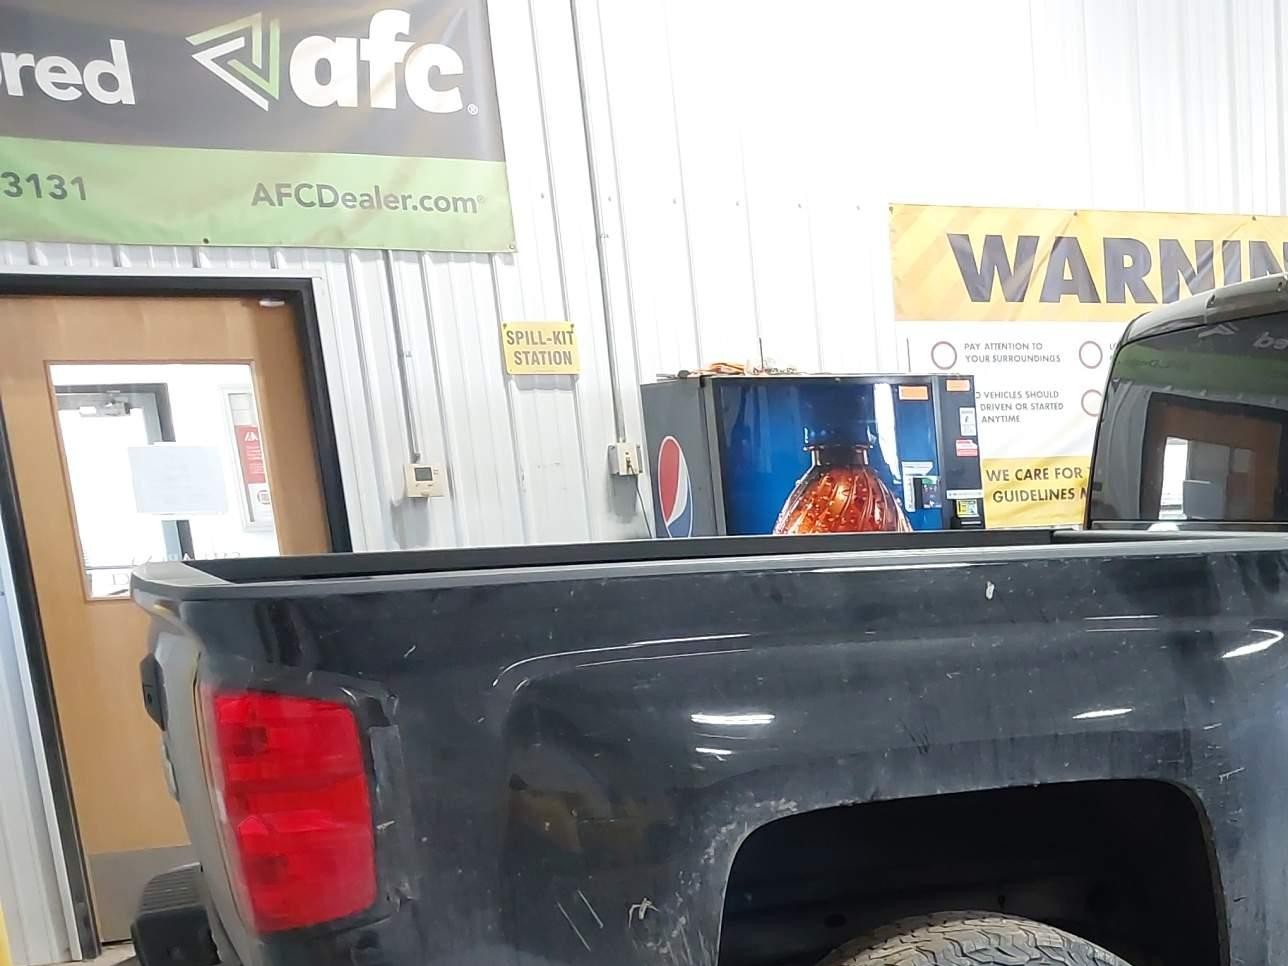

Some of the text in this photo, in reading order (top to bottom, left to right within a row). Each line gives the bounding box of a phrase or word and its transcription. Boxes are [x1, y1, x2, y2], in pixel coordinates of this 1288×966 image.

[0, 39, 136, 105] red
[251, 182, 478, 213] AFCDealer.com
[506, 330, 574, 345] SPILL-KIT
[514, 350, 573, 366] STATION
[965, 355, 1061, 363] YOUR SURROUNDINGS
[983, 391, 1022, 399] VEHICLES
[980, 403, 1012, 411] DRIVEN
[1030, 402, 1064, 410] STARTED
[982, 415, 1020, 423] ANYTIME
[986, 467, 1082, 482] WE CARE FOR
[992, 488, 1075, 503] GUIDELINES
